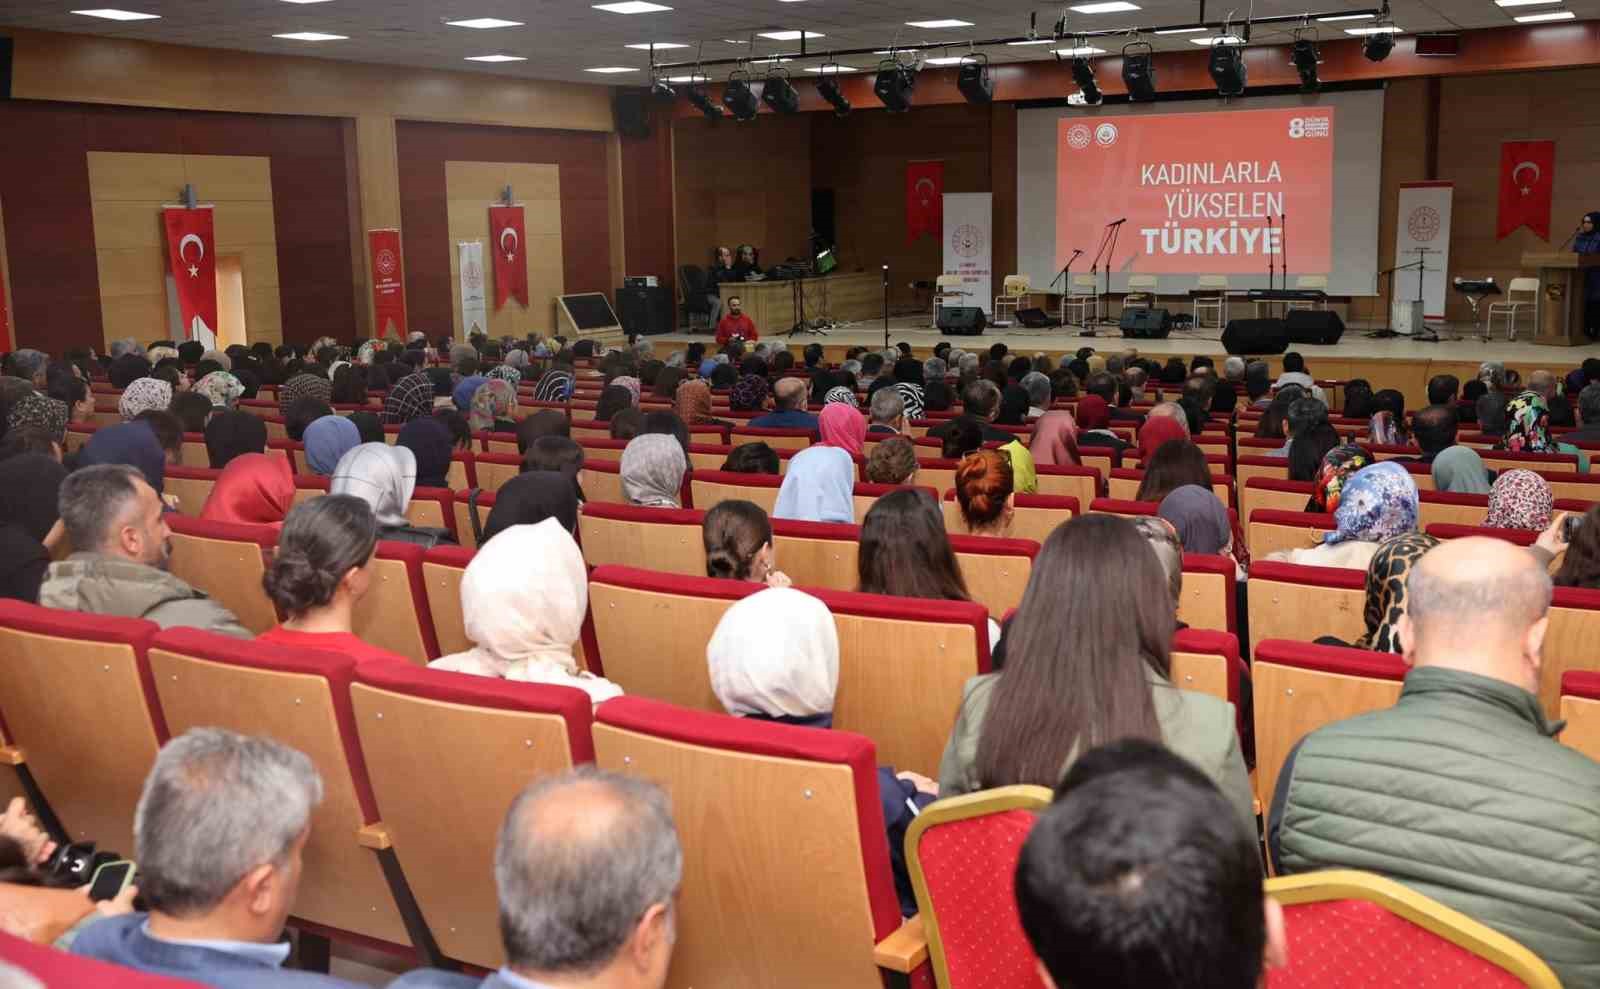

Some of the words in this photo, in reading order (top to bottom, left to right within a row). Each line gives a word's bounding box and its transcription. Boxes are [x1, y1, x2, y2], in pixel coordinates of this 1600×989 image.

[1289, 118, 1304, 138] 8
[1141, 160, 1282, 185] KADINLARLA
[1164, 188, 1283, 218] YÜKSELEN
[1141, 221, 1282, 255] TÜRKİYE
